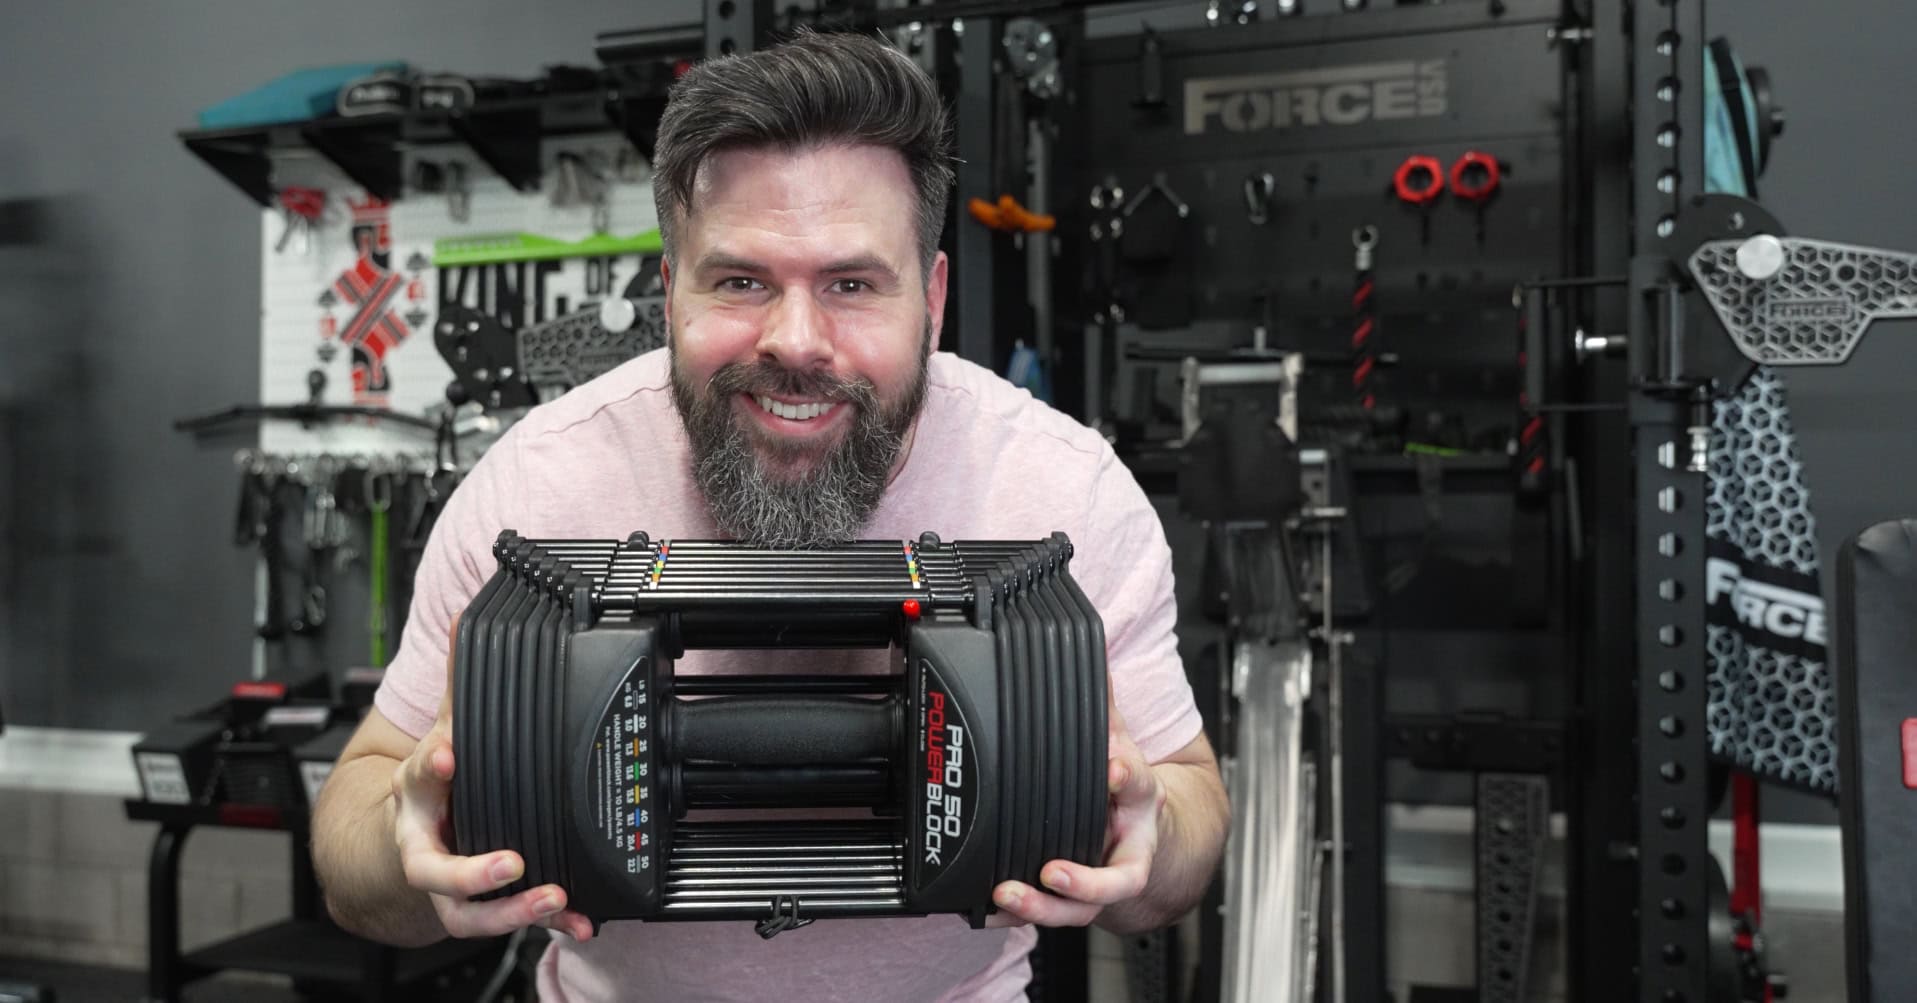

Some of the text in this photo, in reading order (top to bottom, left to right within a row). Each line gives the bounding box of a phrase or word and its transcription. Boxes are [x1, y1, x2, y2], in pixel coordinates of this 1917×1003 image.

[1183, 60, 1415, 135] FORCE
[1706, 557, 1828, 645] FRCE
[624, 695, 633, 708] 6.8
[638, 693, 647, 704] 15
[624, 718, 633, 732] 9.0
[639, 715, 647, 729] 20
[613, 713, 622, 750] HANDLE
[639, 740, 648, 752] 25
[614, 751, 622, 786] WEIGHT
[639, 762, 648, 776] 30
[925, 691, 945, 866] POWERBLOCK
[944, 724, 963, 838] PRO 50
[640, 786, 648, 799] 35
[615, 795, 622, 805] 10
[615, 806, 624, 834] LB/4.5
[640, 809, 649, 823] 40
[616, 835, 624, 849] KG
[627, 834, 636, 852] 20.4
[641, 833, 649, 846] 45
[627, 858, 636, 873] 22.7
[641, 855, 650, 869] 50
